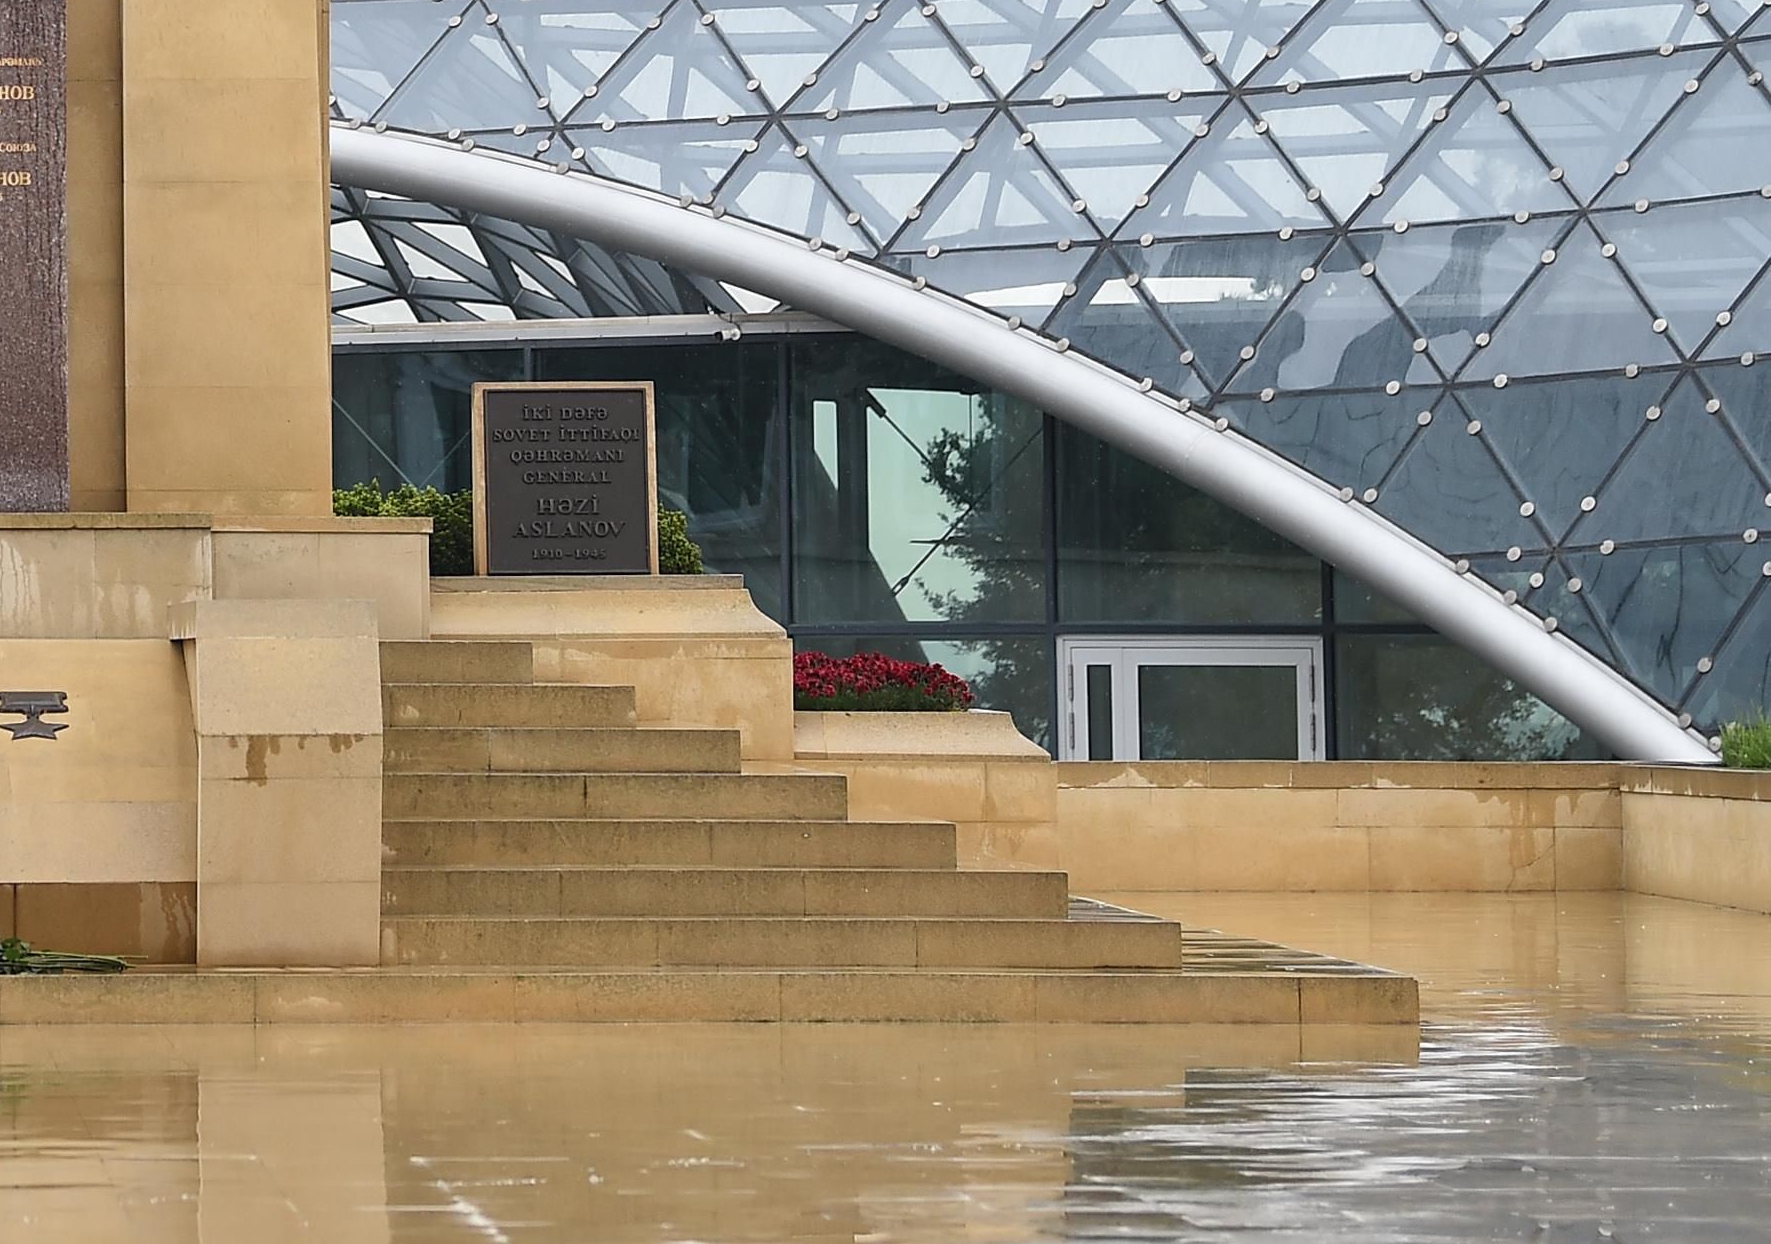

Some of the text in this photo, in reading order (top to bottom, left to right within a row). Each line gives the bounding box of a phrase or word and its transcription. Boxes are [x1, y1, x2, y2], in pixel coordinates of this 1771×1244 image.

[523, 404, 609, 420] İKİ DƏFƏ
[493, 424, 640, 443] SOVET İTTİFAQI
[511, 449, 624, 465] QƏHRƏMANI
[538, 494, 600, 515] HƏZİ
[514, 520, 626, 539] ASLANOV
